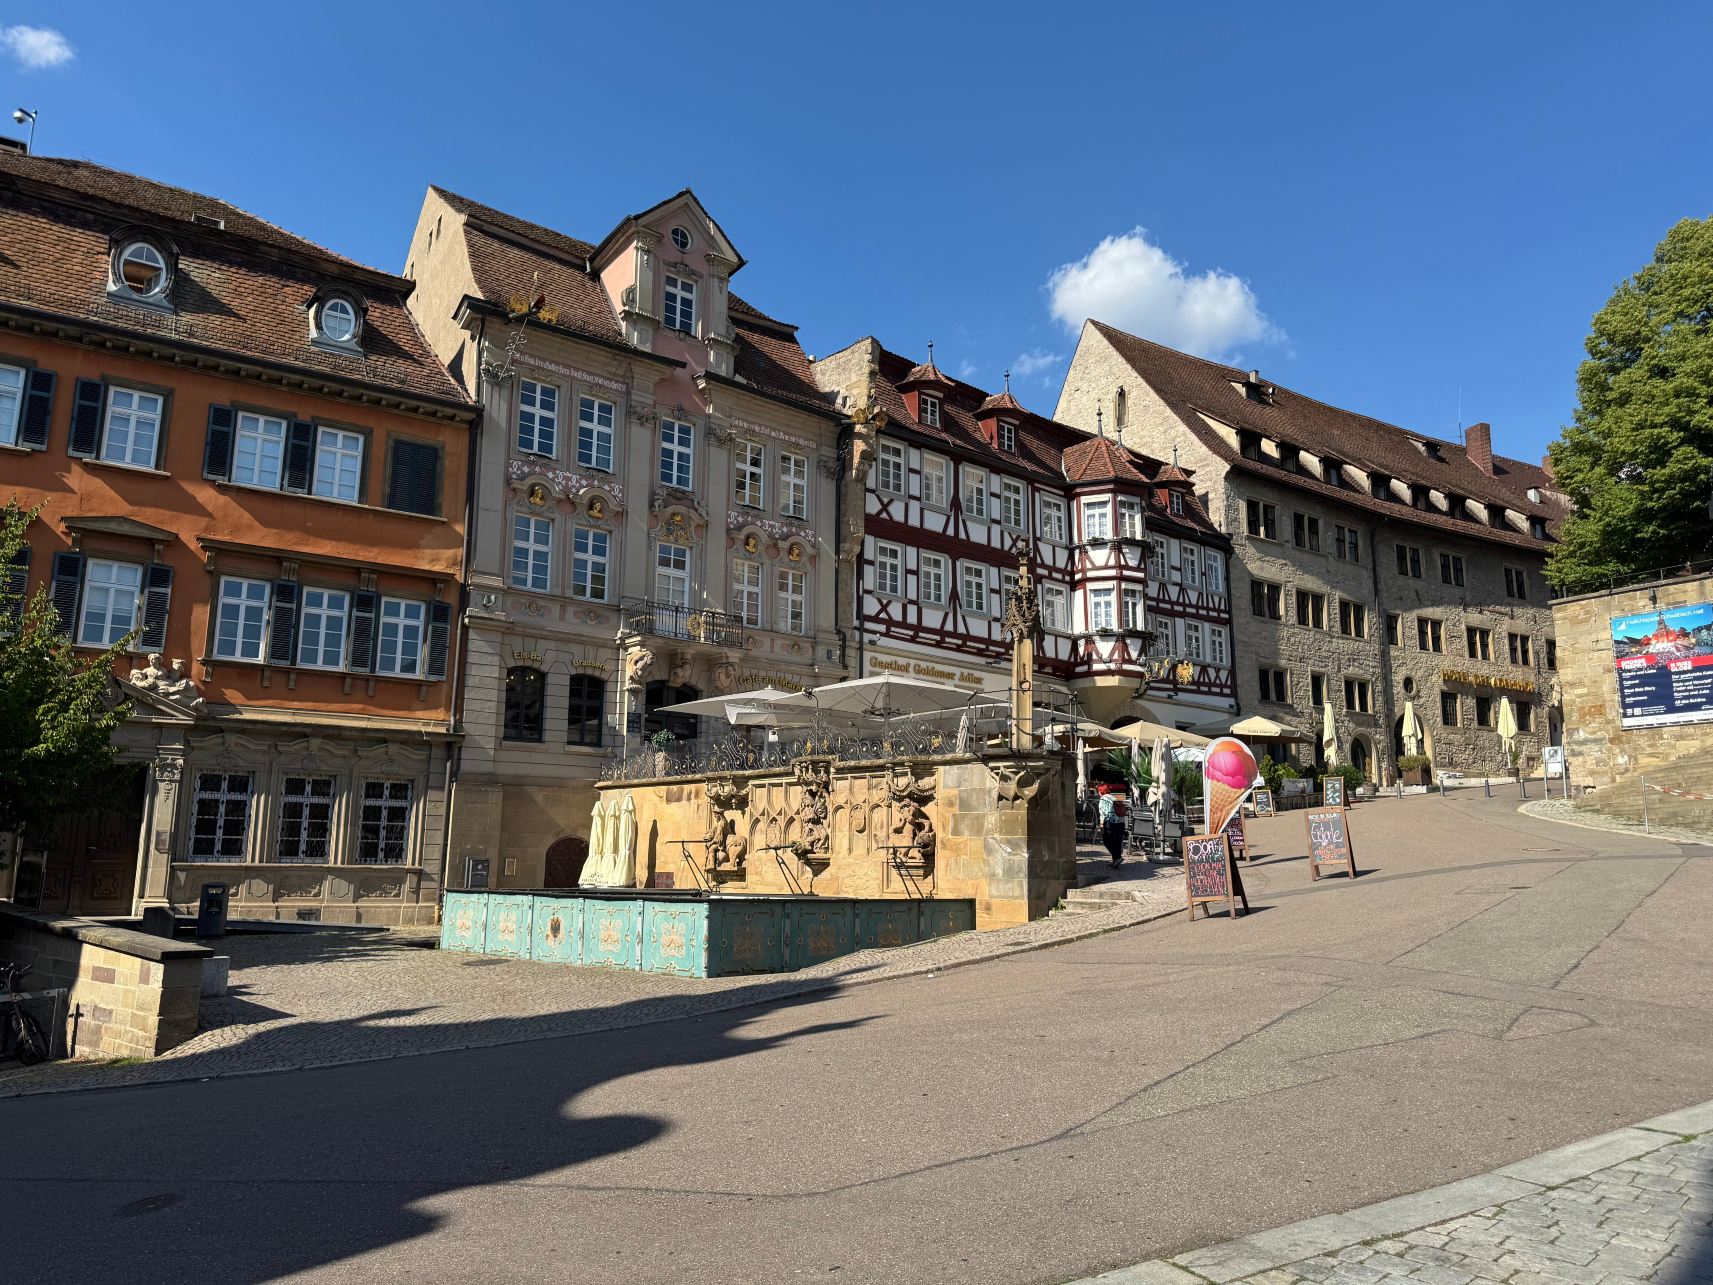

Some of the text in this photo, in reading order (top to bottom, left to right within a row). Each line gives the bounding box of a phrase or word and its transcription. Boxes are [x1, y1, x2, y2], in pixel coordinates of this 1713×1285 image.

[514, 651, 544, 662] Eis-Bar
[573, 659, 610, 671] Brasserie
[869, 656, 985, 685] Gasthof Goldener Adler
[738, 672, 760, 685] Café
